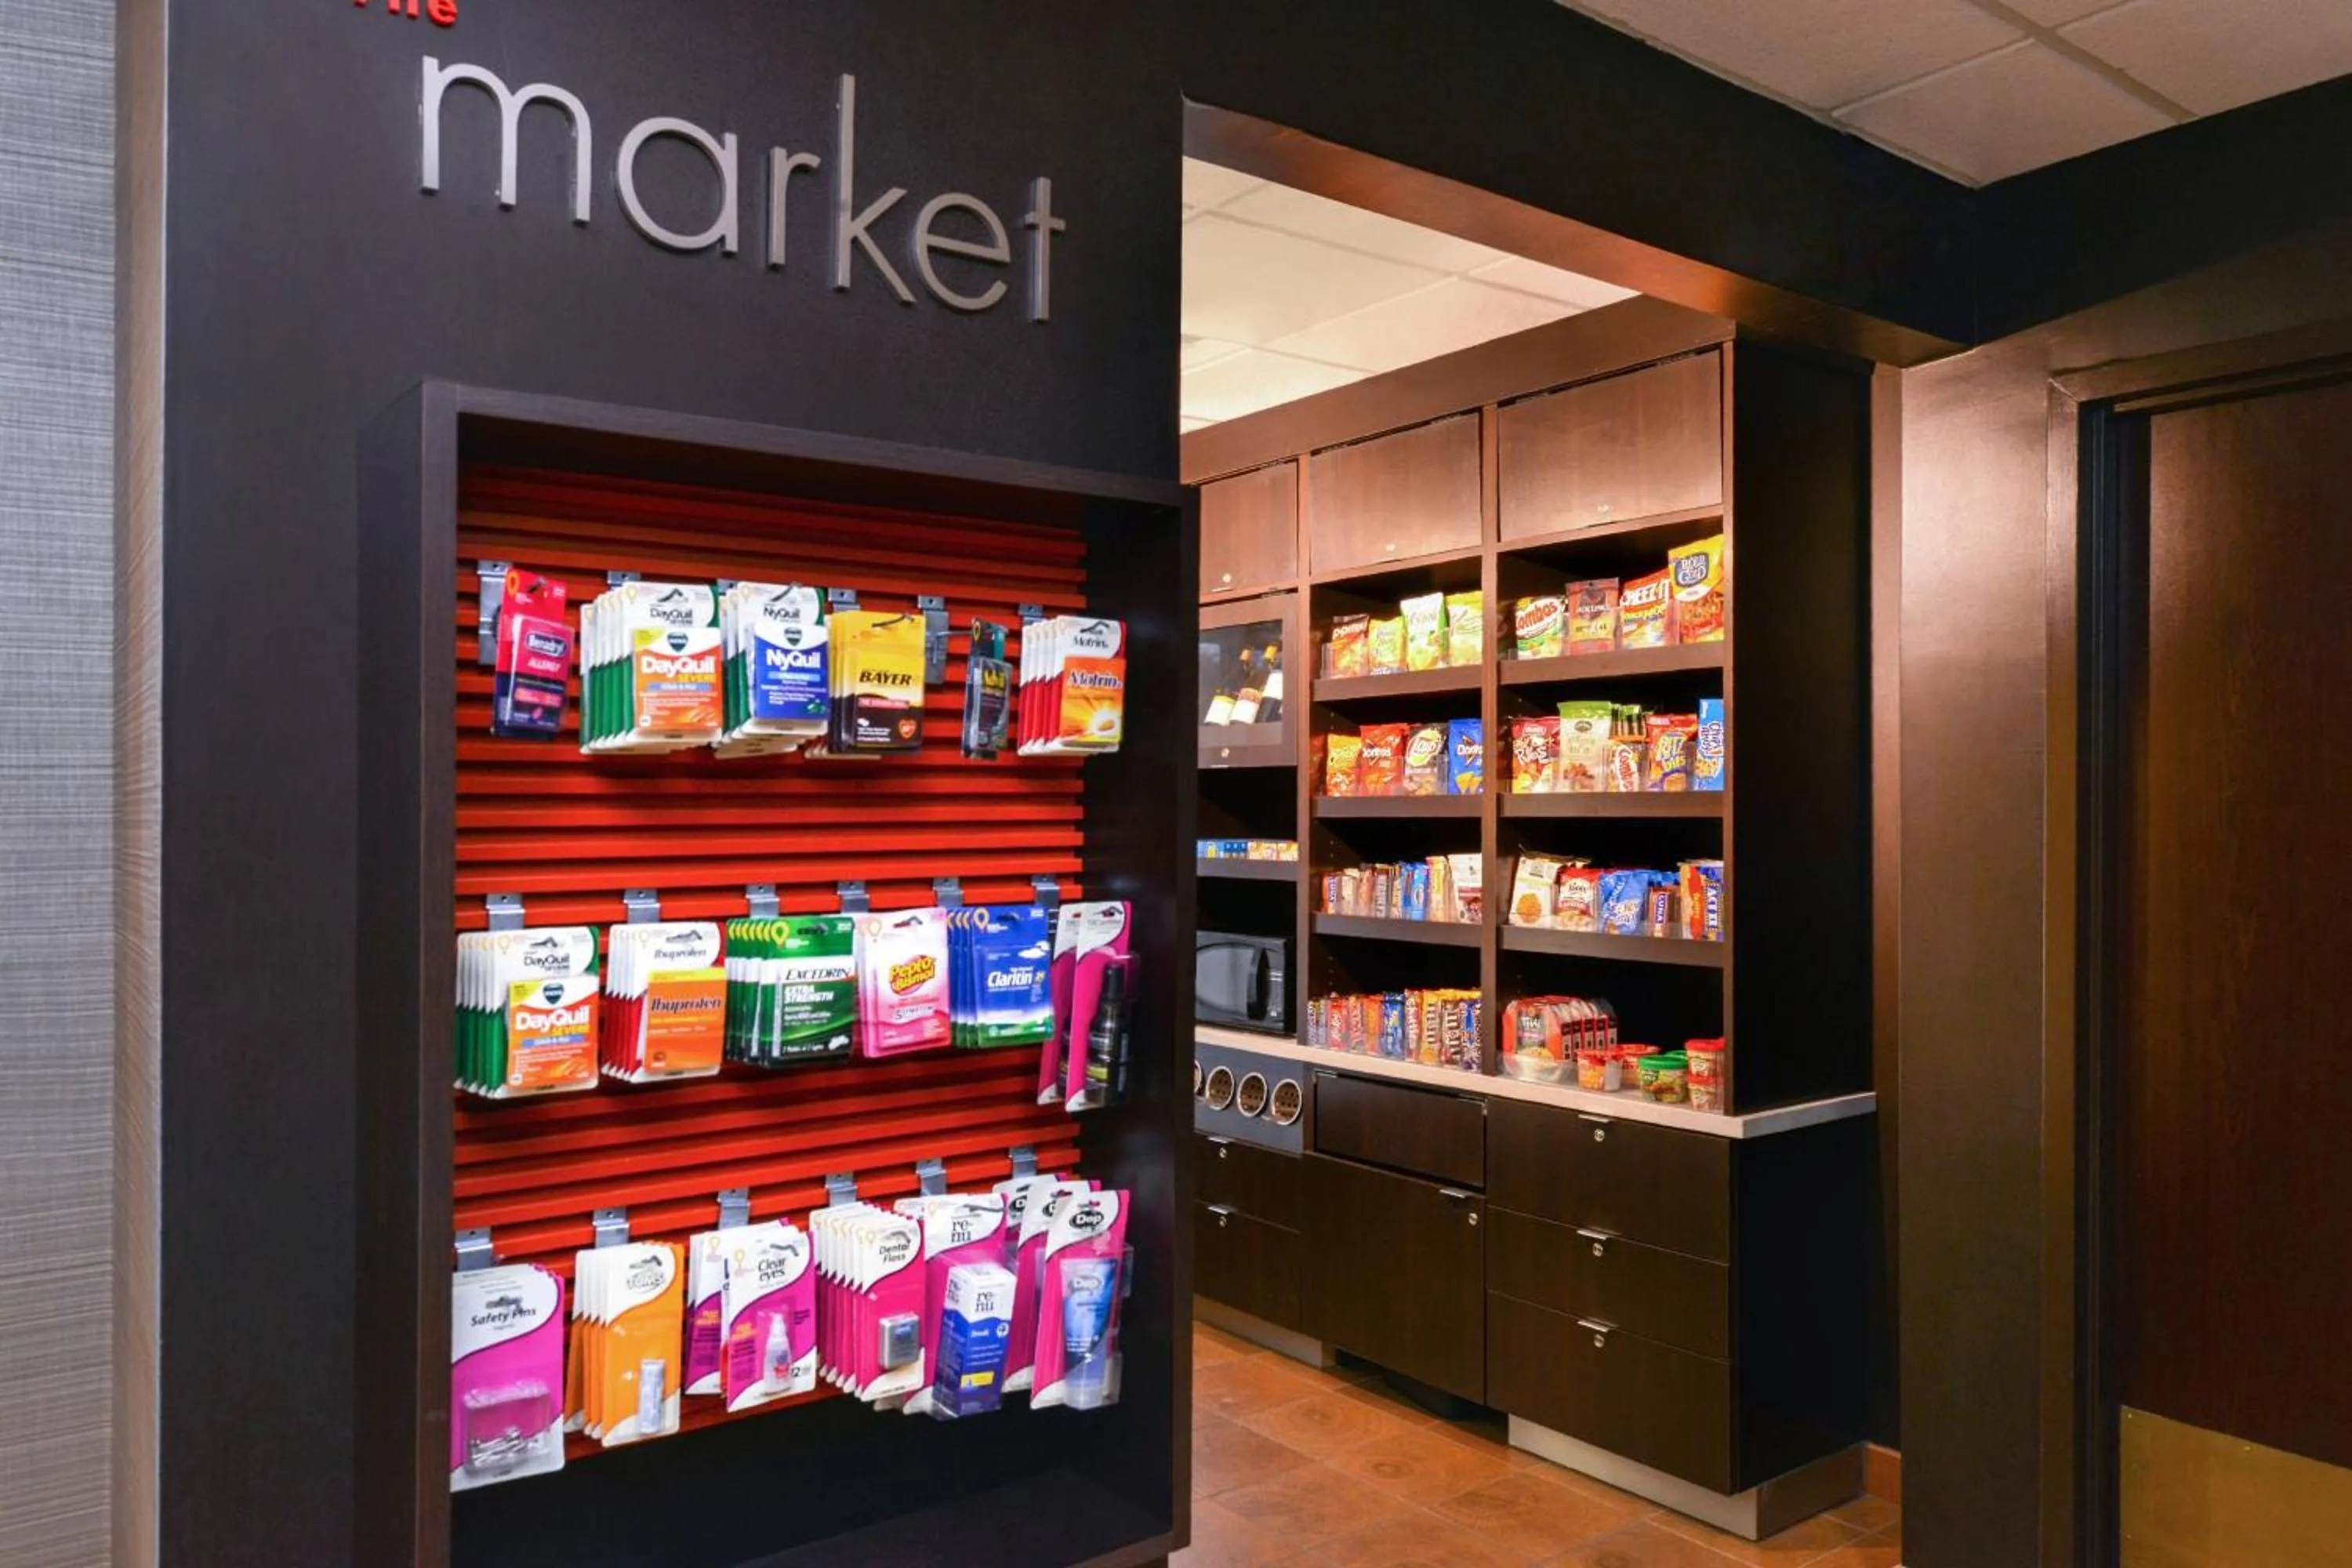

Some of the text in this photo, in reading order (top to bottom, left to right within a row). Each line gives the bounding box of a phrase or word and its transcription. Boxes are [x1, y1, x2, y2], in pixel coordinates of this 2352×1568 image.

[419, 55, 1067, 321] market
[650, 607, 693, 621] DayQuil
[763, 606, 800, 620] NyQuil
[641, 655, 716, 678] DayQuil
[765, 648, 821, 671] NyQuil
[858, 670, 913, 686] BAYER
[524, 953, 570, 967] DayQuil
[987, 969, 1033, 988] Claritin
[651, 996, 721, 1014] Ibuprofen
[515, 1004, 590, 1033] DayQuil
[1076, 1213, 1102, 1229] Dep
[879, 1243, 910, 1255] Dental
[757, 1256, 787, 1272] Clear
[758, 1268, 786, 1283] eyes
[470, 1311, 510, 1327] Safety
